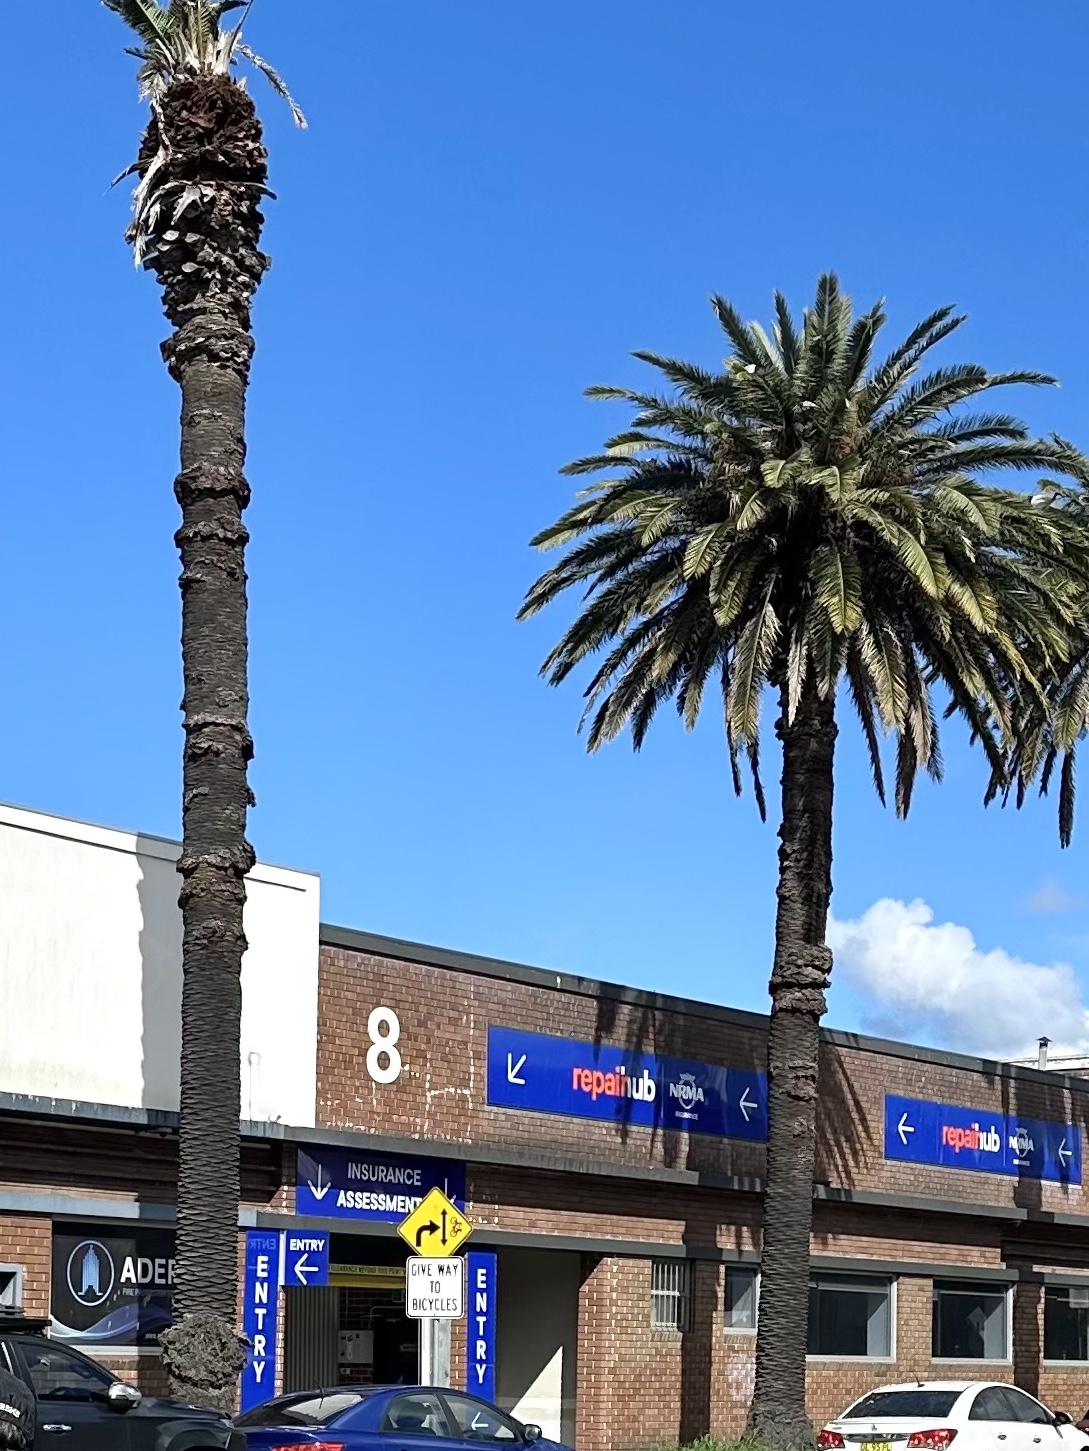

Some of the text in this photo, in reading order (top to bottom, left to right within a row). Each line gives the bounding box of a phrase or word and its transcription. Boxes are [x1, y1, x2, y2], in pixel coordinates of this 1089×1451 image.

[366, 1006, 401, 1084] 8
[669, 1082, 705, 1102] NRMA
[347, 1162, 422, 1186] INSURANCE
[289, 1238, 325, 1252] ENTRY
[411, 1263, 459, 1277] GIVE WAY
[429, 1280, 441, 1294] TO
[412, 1298, 458, 1312] BICYCLES
[252, 1255, 269, 1383] ENTRY
[475, 1268, 488, 1384] ENTRY
